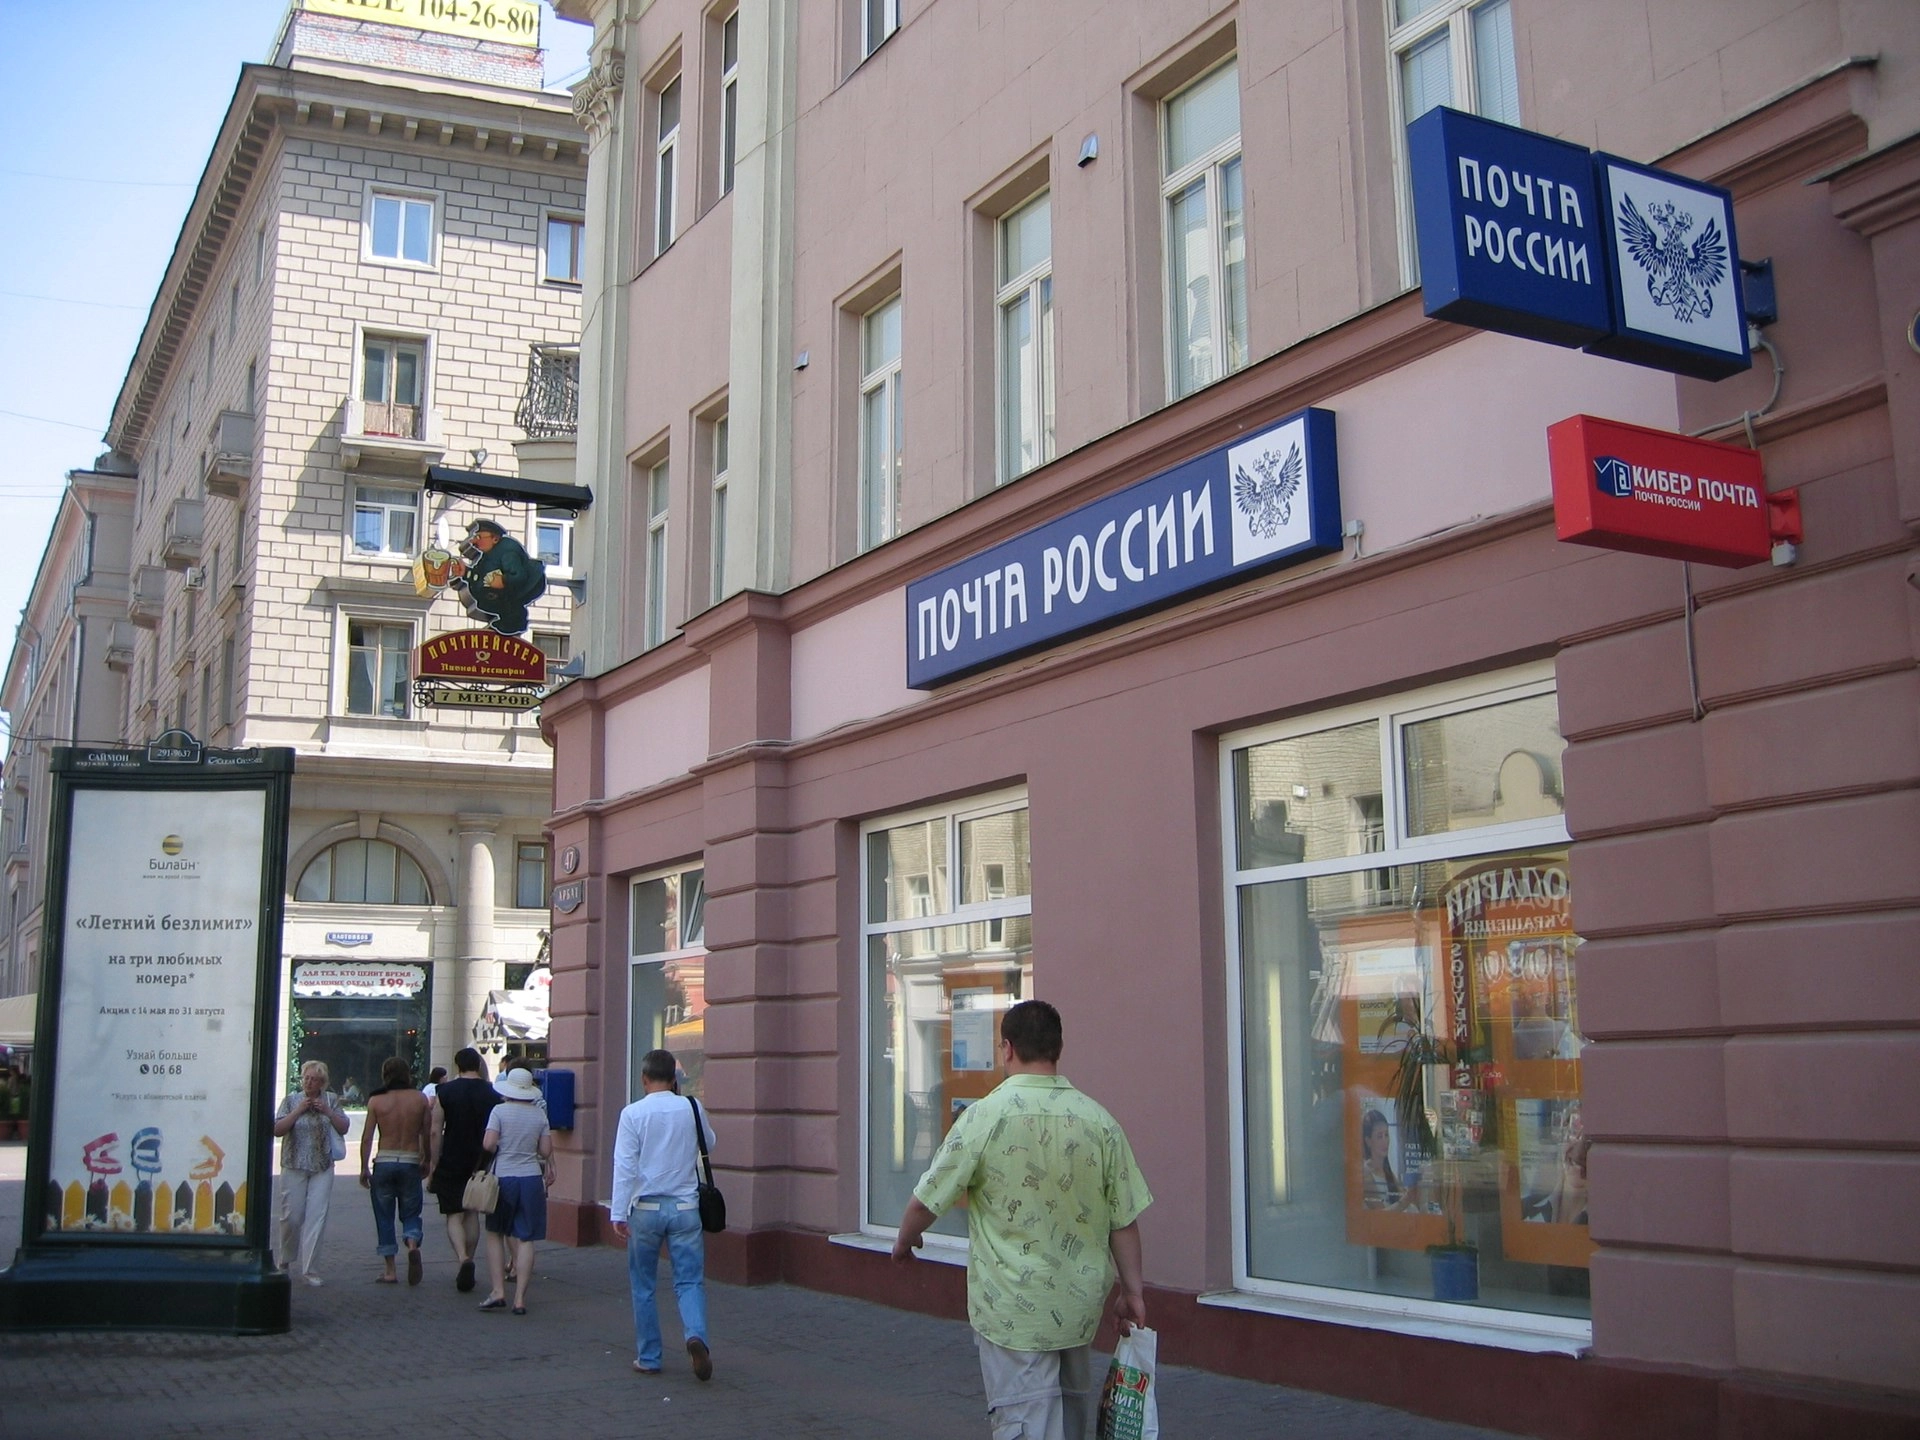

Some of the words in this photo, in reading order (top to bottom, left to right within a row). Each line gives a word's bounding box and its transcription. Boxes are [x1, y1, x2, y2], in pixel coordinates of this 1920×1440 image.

[418, 0, 534, 35] 104-26-80
[1458, 155, 1584, 228] ПОЧТА
[1464, 213, 1592, 285] РОССИИ
[1631, 464, 1692, 496] КИБЕР
[1697, 477, 1759, 509] ПОЧТА
[1634, 489, 1665, 506] ПОЧТА
[1665, 495, 1701, 512] РОССИИ
[918, 561, 1028, 662] ПОЧТА
[1043, 479, 1215, 615] РОССИИ
[427, 634, 540, 666] ПОЧТМЕЙСТЕР
[440, 662, 478, 673] Пивной
[480, 666, 526, 676] ресторан
[441, 691, 450, 702] 7
[458, 692, 531, 706] МЕТРОВ
[88, 752, 130, 763] САЙМОН
[564, 851, 574, 870] 47
[76, 914, 156, 931] «Летний
[161, 914, 253, 932] безлимит»
[108, 955, 126, 965] на
[129, 955, 153, 968] три
[156, 953, 223, 966] любимых
[379, 977, 404, 988] 199
[99, 1005, 130, 1017] Акция
[131, 1007, 137, 1015] с
[138, 1006, 148, 1015] 14
[149, 1008, 166, 1016] мая
[168, 1008, 180, 1016] по
[182, 1006, 192, 1016] 31
[194, 1008, 225, 1017] августа
[126, 1049, 156, 1061] Узнай
[158, 1049, 198, 1061] больше
[152, 1064, 165, 1075] 06
[168, 1064, 182, 1075] 68
